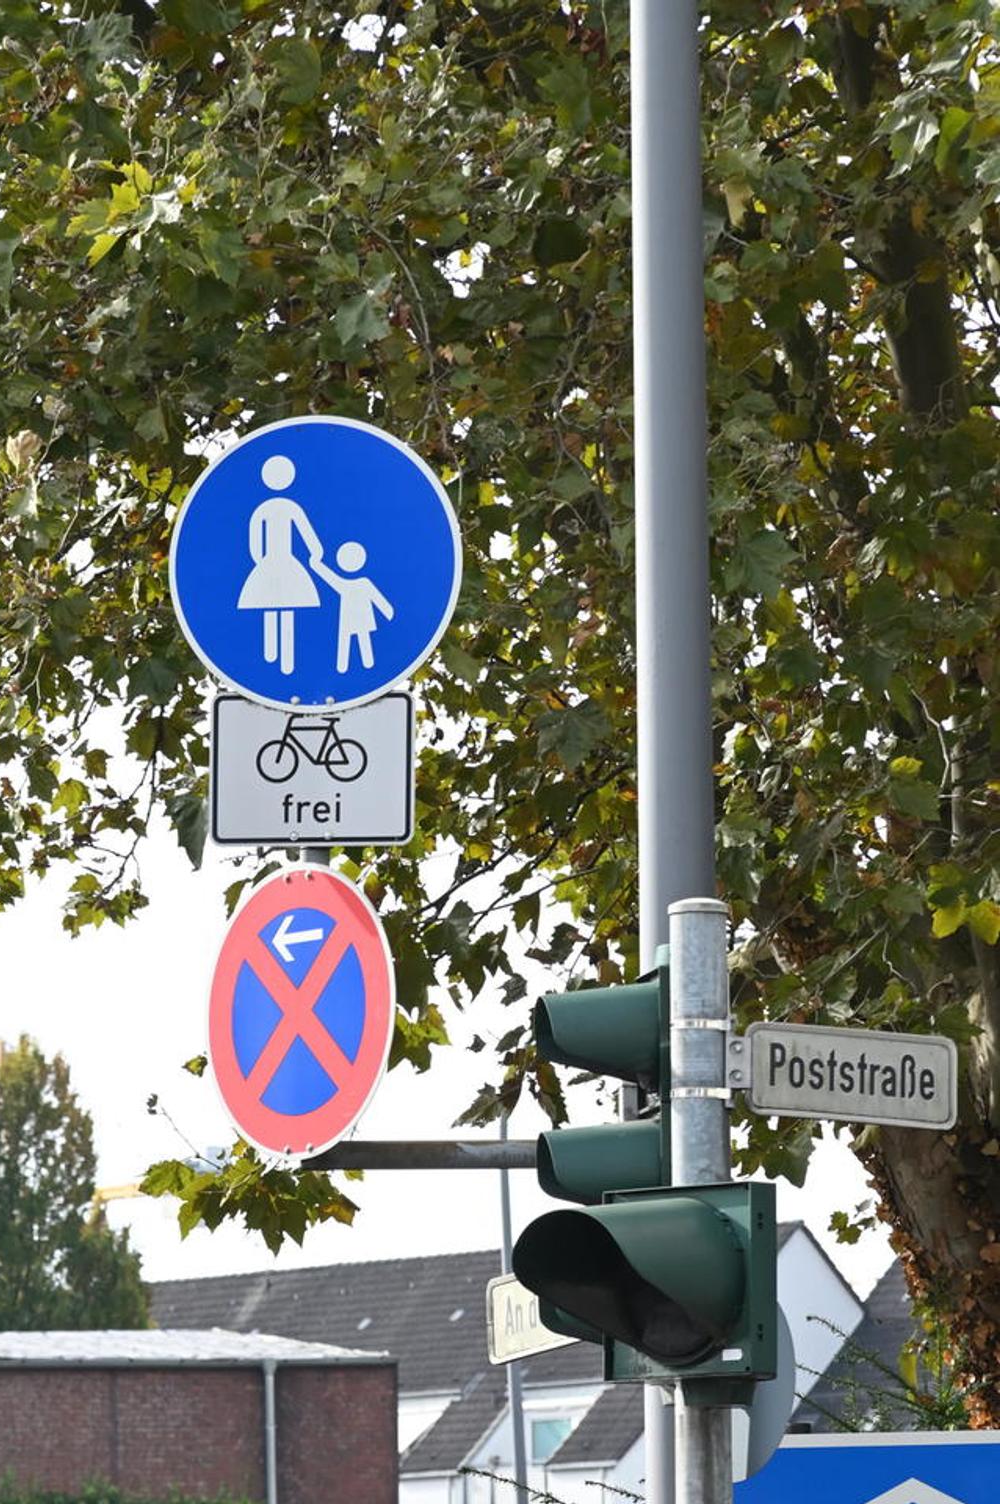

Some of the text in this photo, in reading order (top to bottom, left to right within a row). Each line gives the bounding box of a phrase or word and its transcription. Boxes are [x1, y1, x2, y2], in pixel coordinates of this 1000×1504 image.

[282, 793, 341, 824] frei
[769, 1042, 935, 1100] Poststraße
[504, 1294, 524, 1337] An
